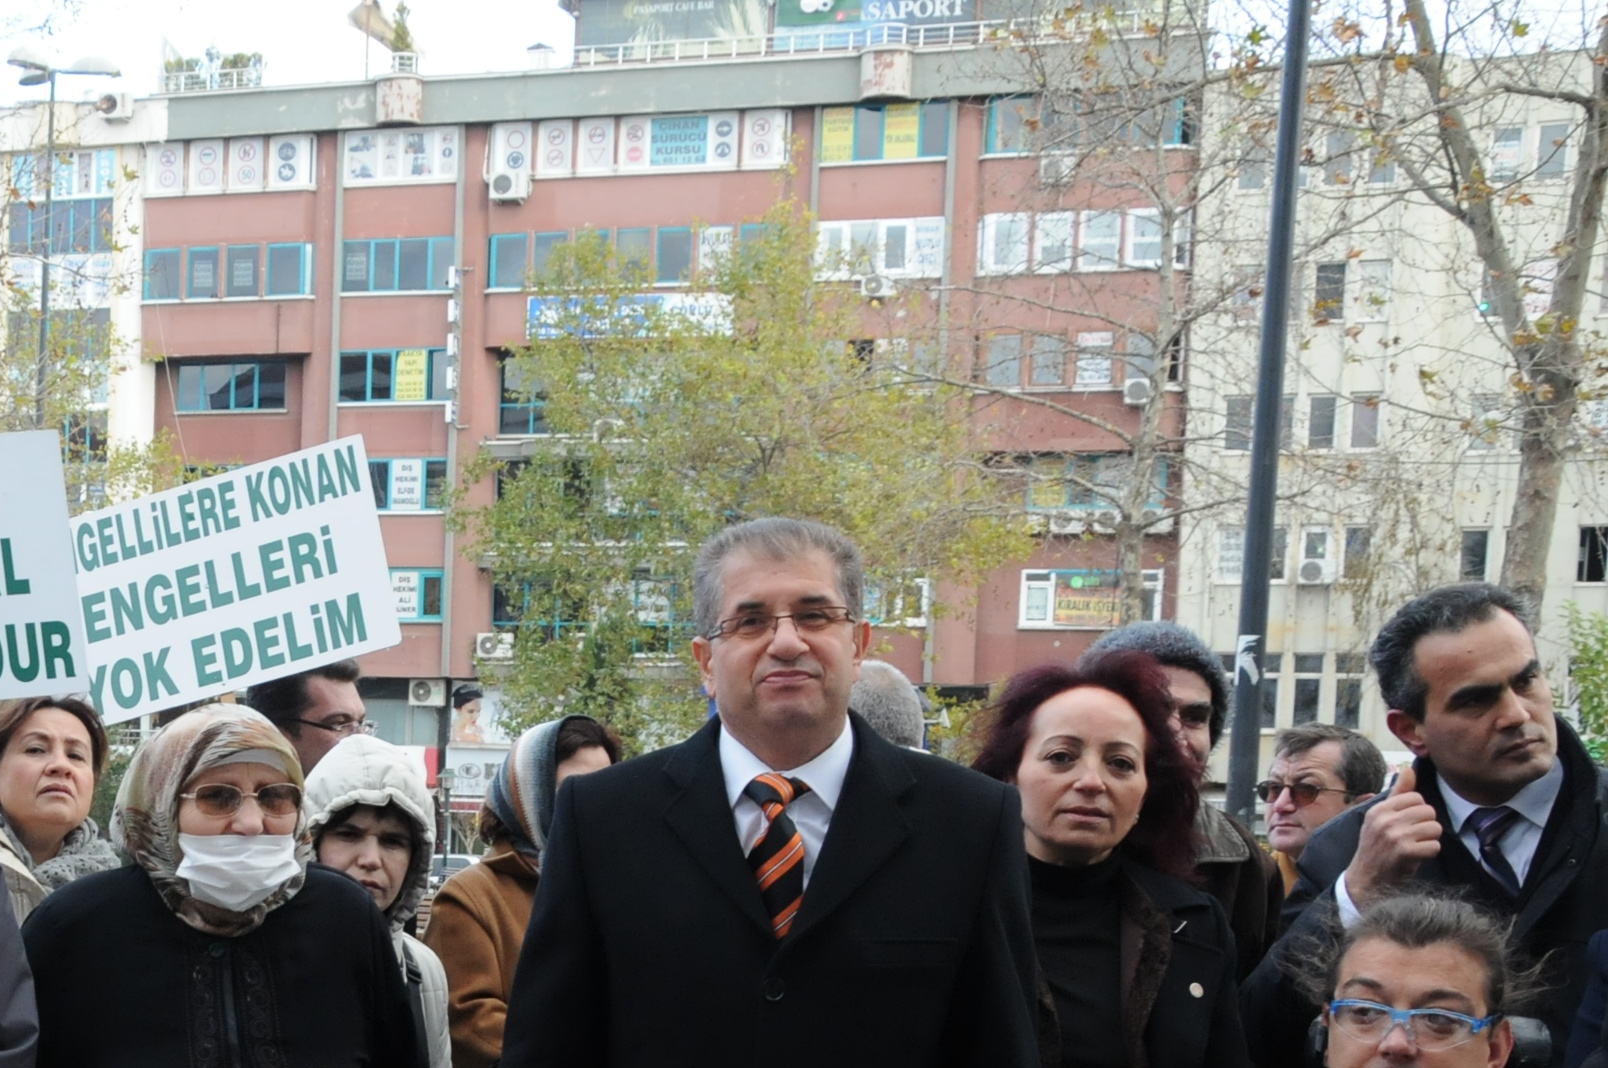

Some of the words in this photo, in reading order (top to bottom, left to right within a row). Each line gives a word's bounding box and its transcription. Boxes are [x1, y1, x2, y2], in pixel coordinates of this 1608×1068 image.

[697, 0, 715, 10] BAR
[655, 144, 702, 156] KURSU
[245, 444, 361, 523] KONAN
[89, 647, 180, 716] YOK
